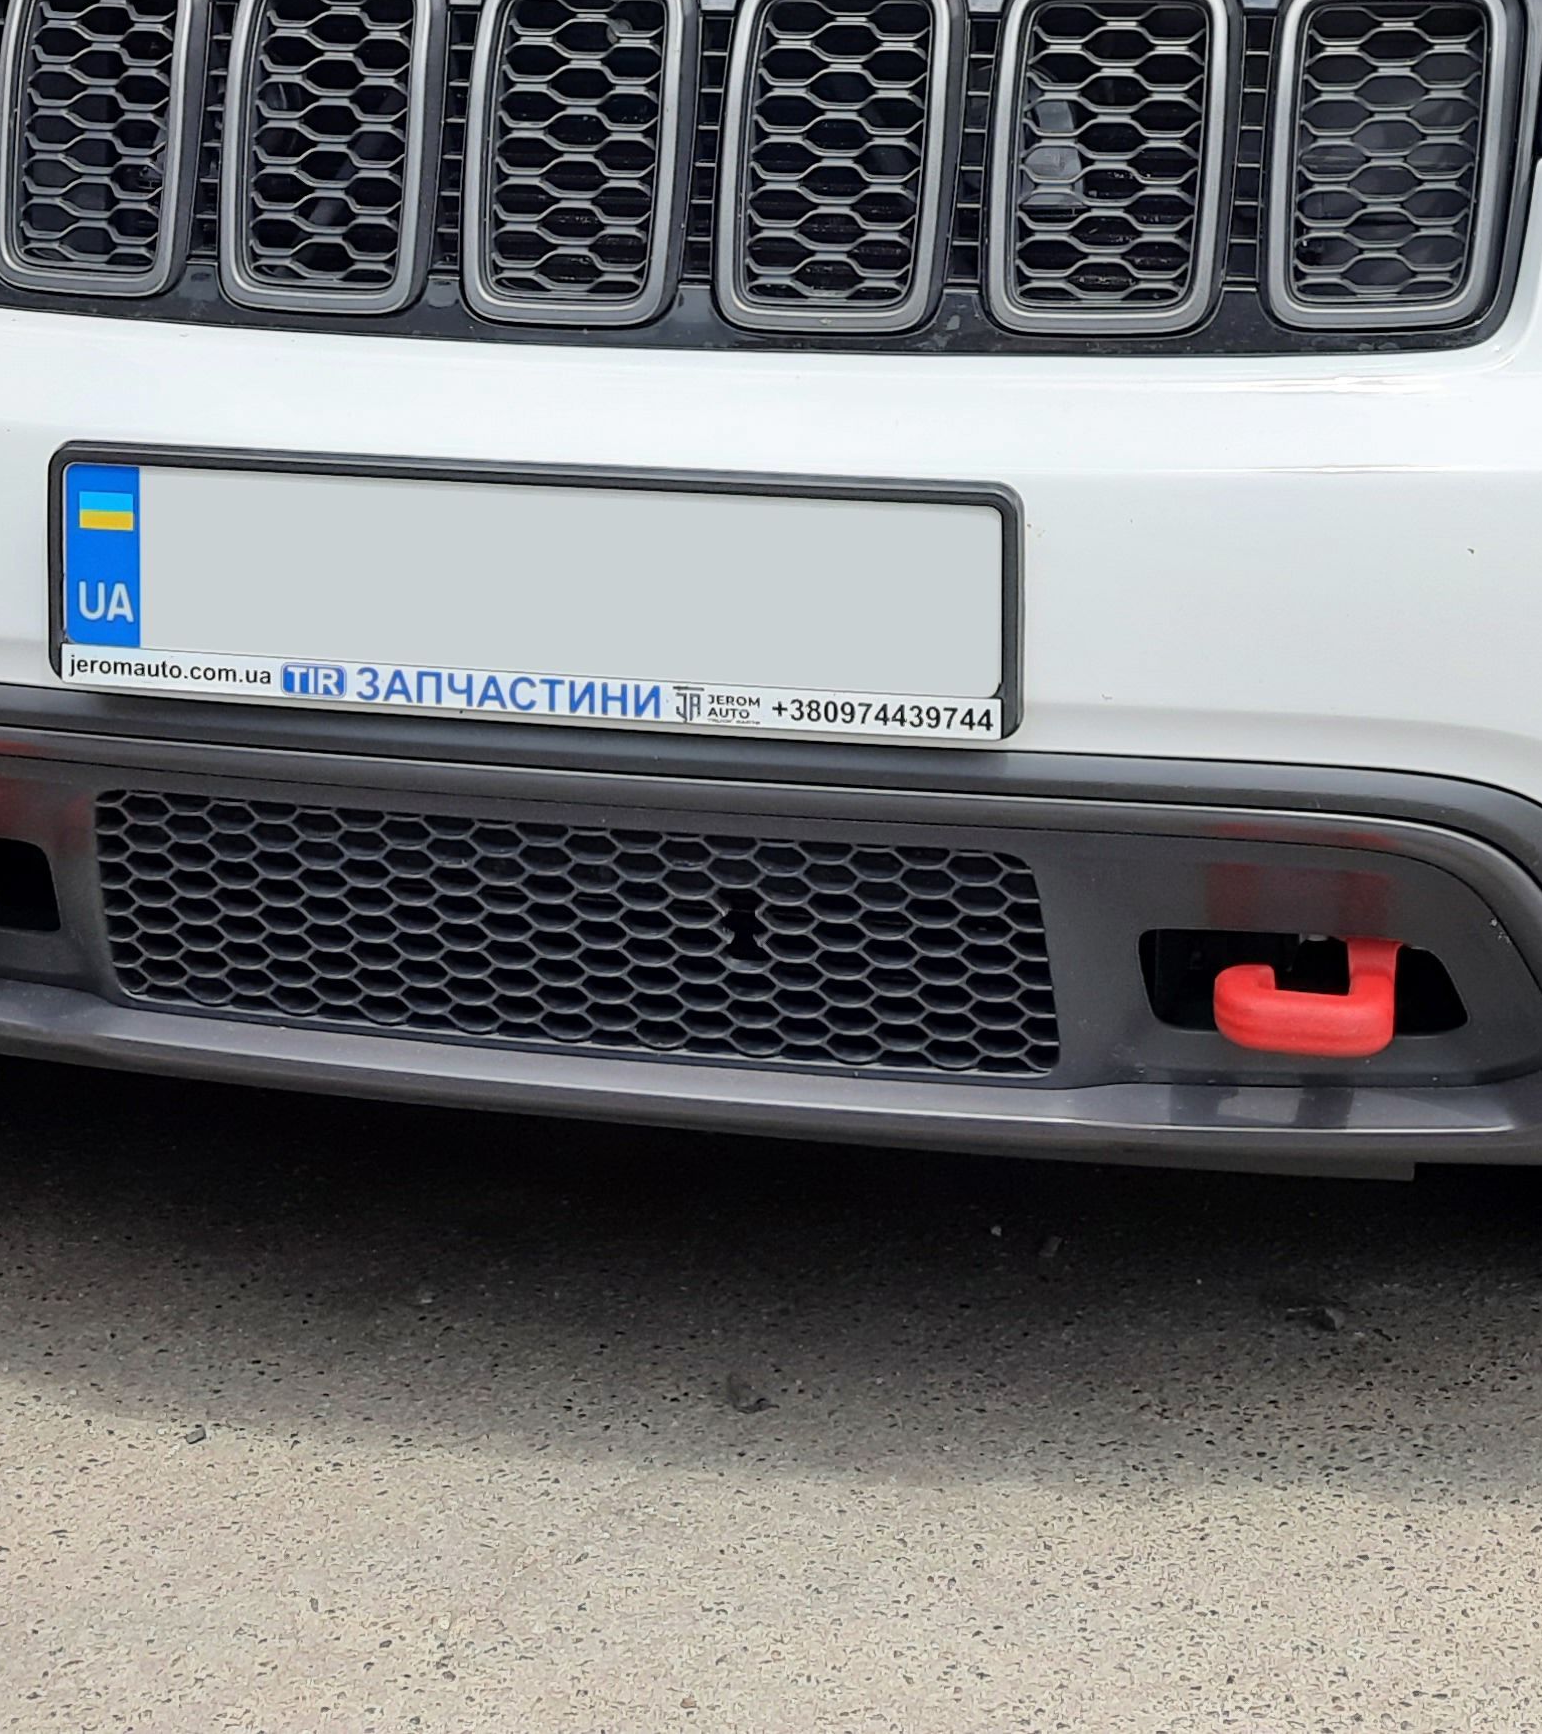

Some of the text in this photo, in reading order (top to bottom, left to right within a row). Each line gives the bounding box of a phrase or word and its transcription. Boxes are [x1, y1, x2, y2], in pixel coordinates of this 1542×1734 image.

[77, 580, 136, 624] UA
[67, 653, 343, 696] jeromauto.com.ua TIR
[355, 666, 662, 719] ЗАПЧАСТИНИ
[707, 694, 761, 708] JEROM
[707, 706, 750, 720] AUTO
[771, 697, 996, 732] +380974439744
